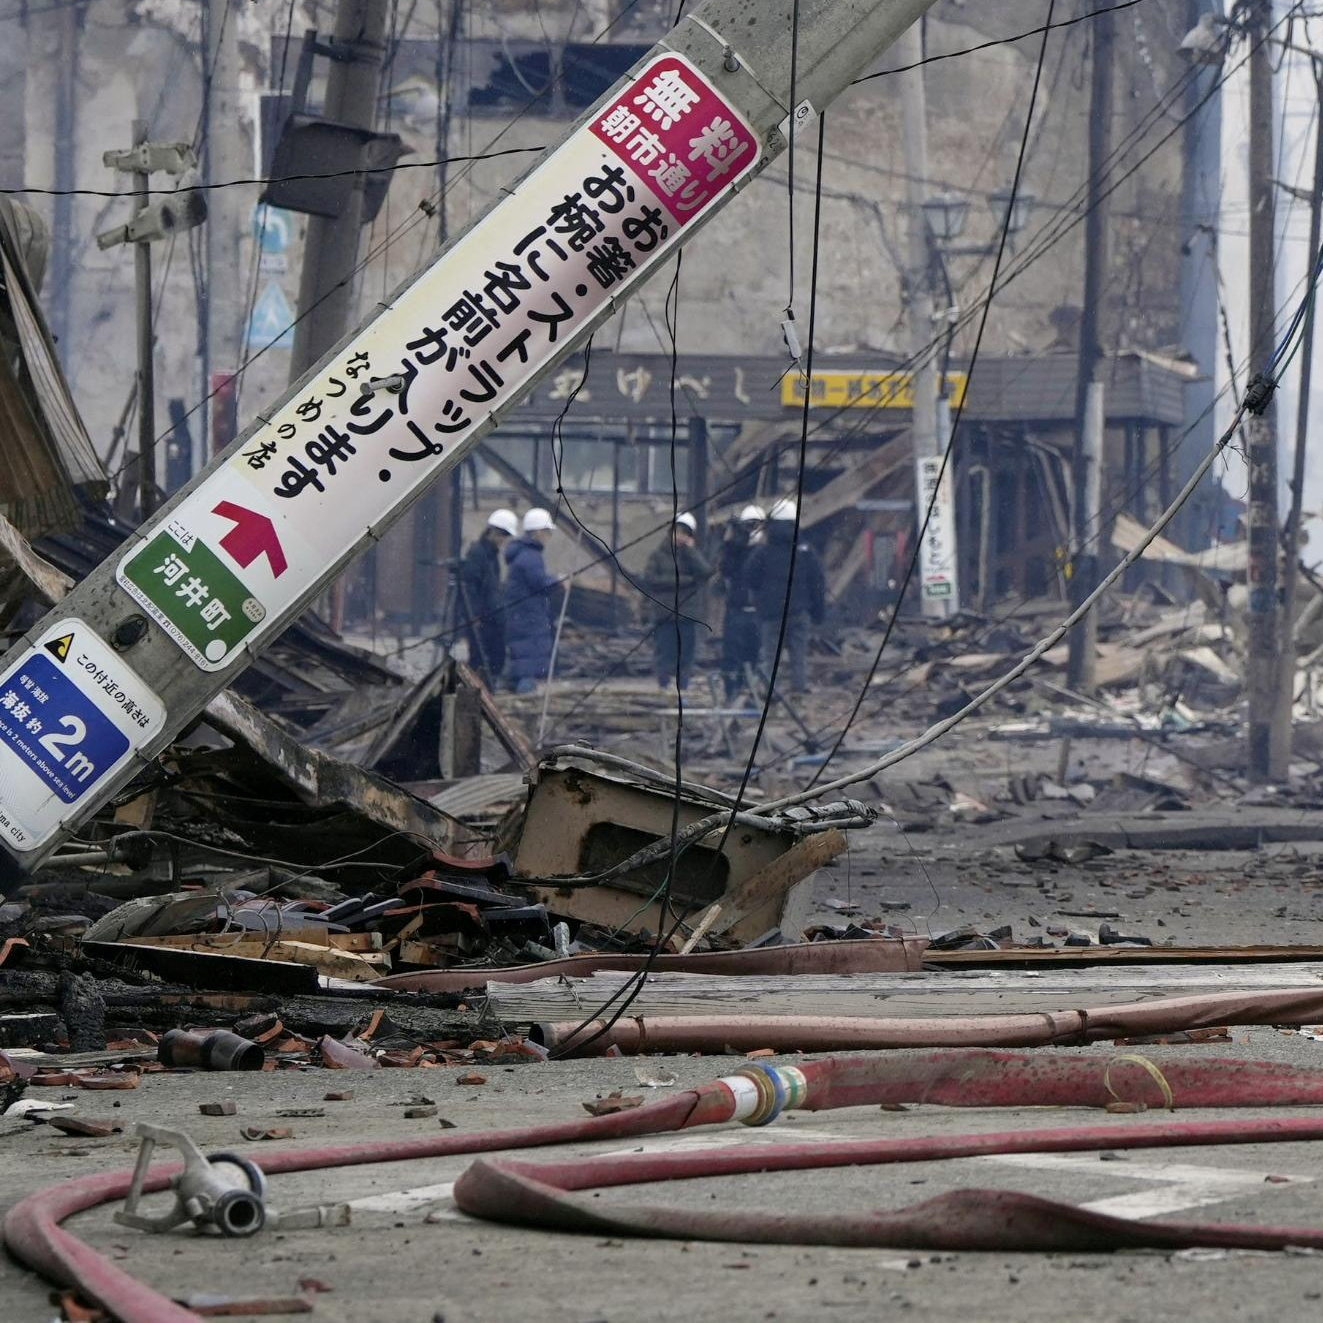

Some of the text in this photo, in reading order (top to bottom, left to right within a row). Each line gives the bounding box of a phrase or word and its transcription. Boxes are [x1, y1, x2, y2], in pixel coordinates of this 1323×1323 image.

[600, 105, 708, 211] 朝市通り
[633, 69, 749, 182] 無料
[273, 164, 636, 499] お椀に名前が入ります
[242, 351, 370, 470] なつめの店
[168, 520, 194, 545] ここは
[153, 553, 232, 631] 河井町
[76, 653, 150, 728] この付近の高さは
[6, 727, 14, 737] is
[12, 733, 19, 741] 2
[16, 738, 38, 761] meters
[36, 758, 55, 778] above
[53, 775, 64, 788] sea
[62, 784, 75, 799] level
[10, 825, 26, 843] city
